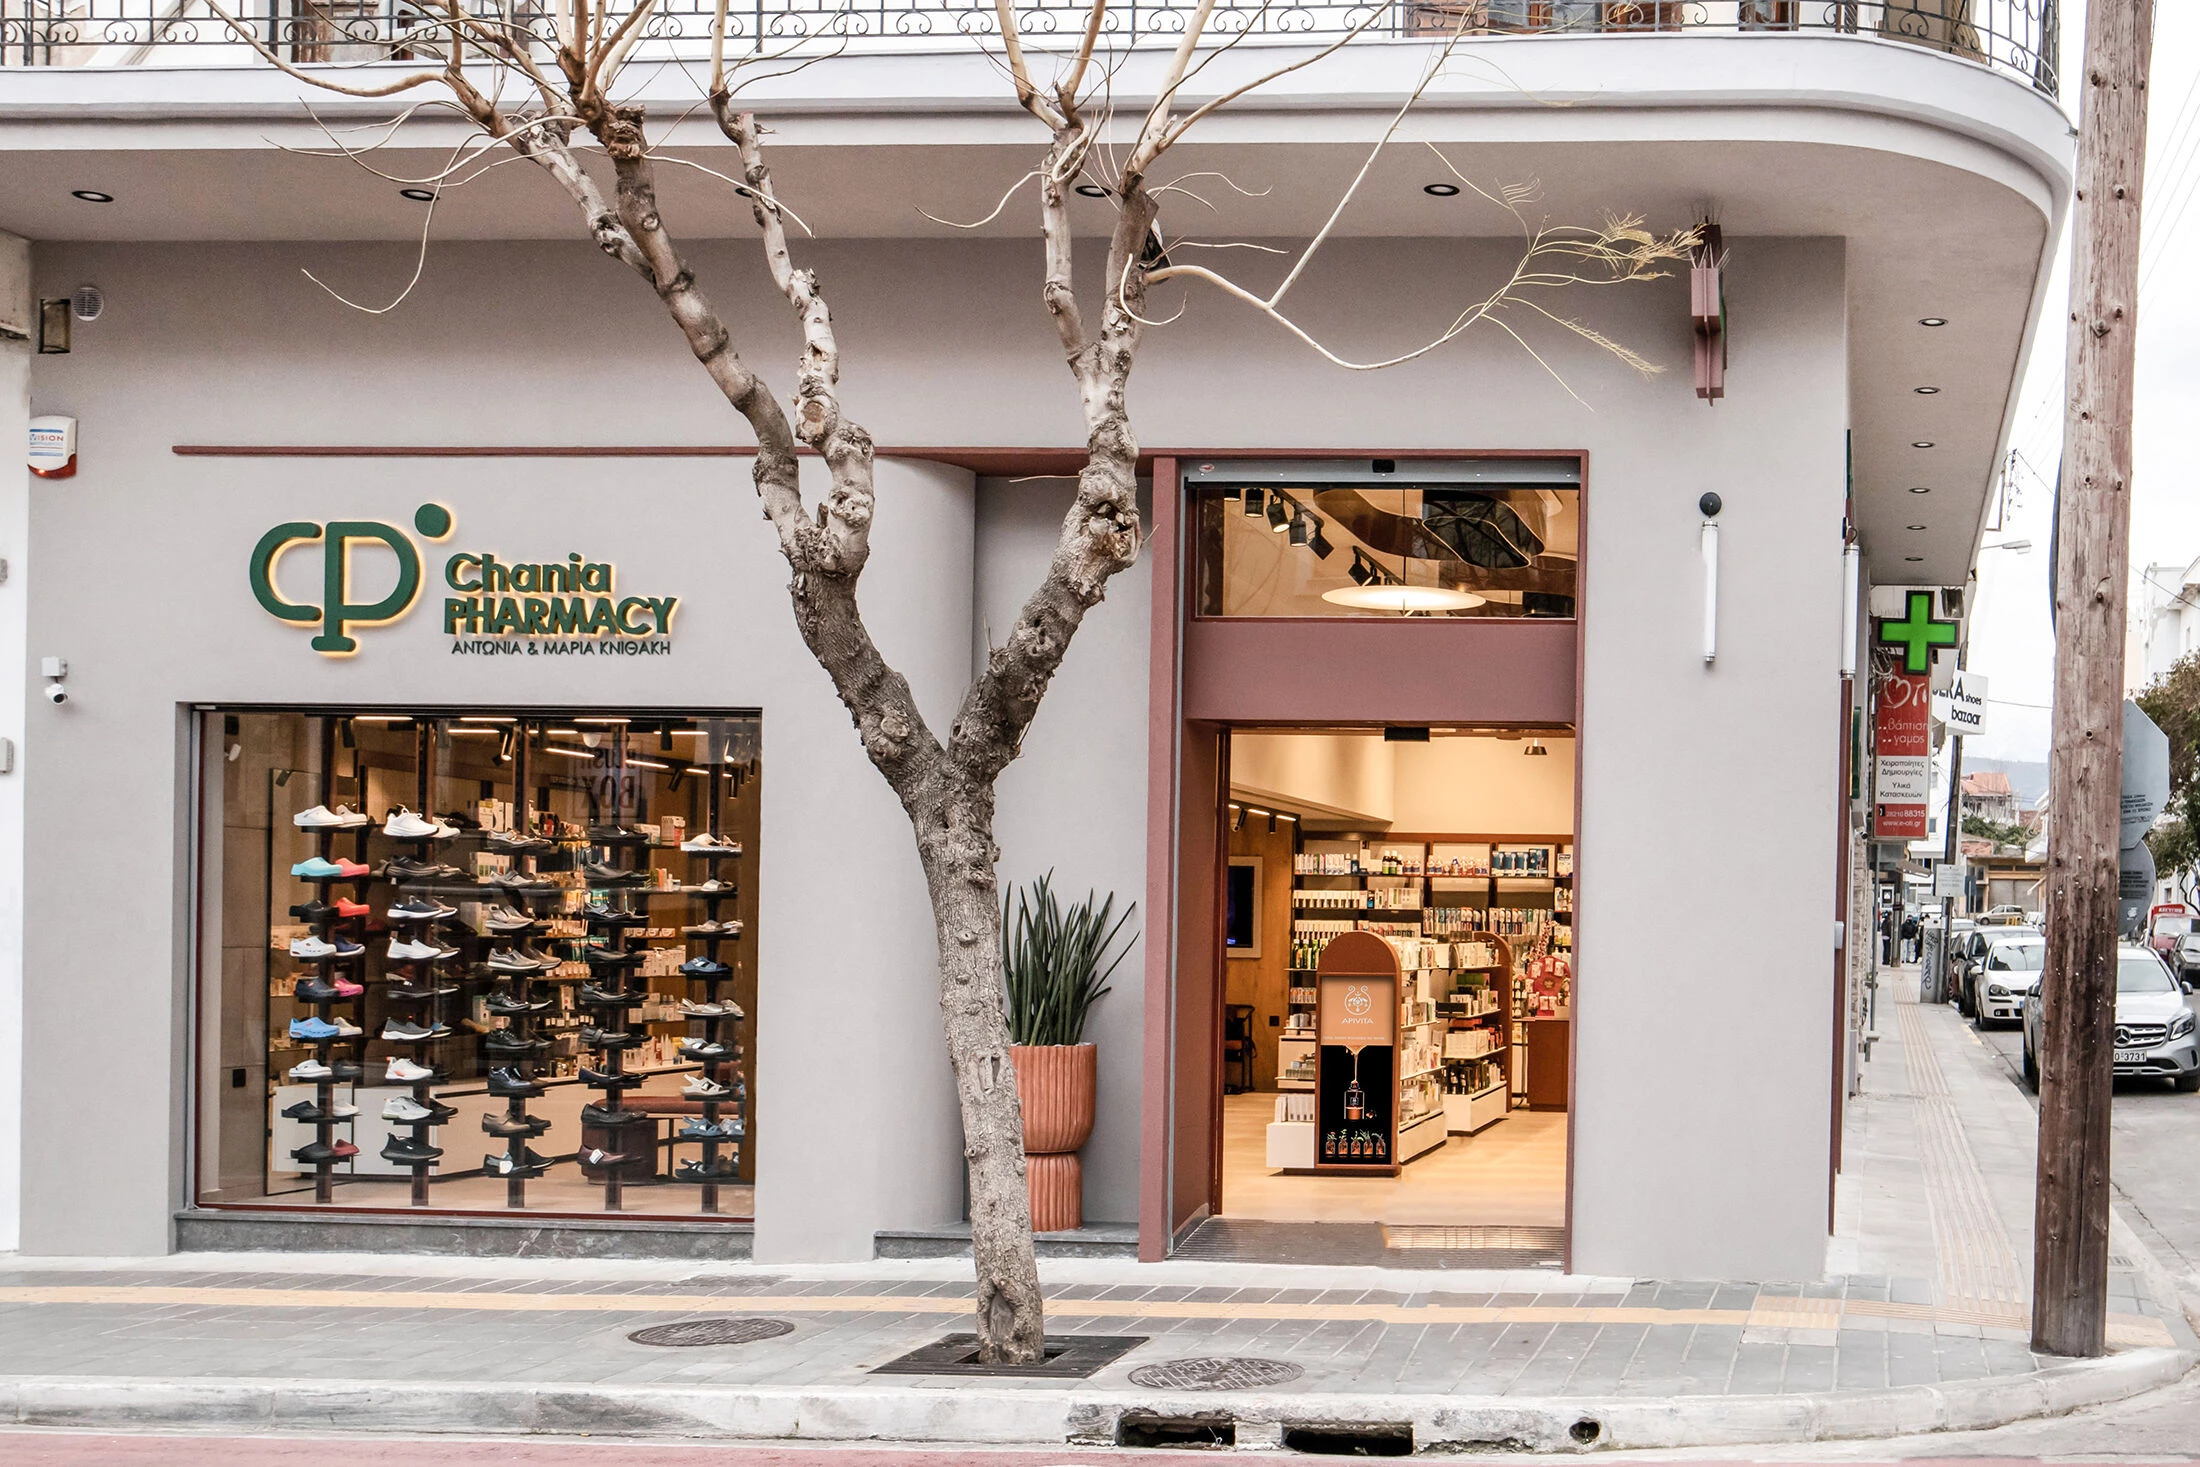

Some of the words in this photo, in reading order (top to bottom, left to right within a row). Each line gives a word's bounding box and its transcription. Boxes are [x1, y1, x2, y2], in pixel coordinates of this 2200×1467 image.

[444, 552, 612, 593] Chania
[444, 597, 678, 635] PHARMACY
[451, 640, 522, 656] ΑΝΤΩΝΙΑ
[527, 641, 539, 656] &
[543, 641, 595, 656] ΜΑΡΙΑ
[599, 640, 671, 656] ΚΝΙΘΑΚΗ
[1341, 1017, 1375, 1025] APIVITA
